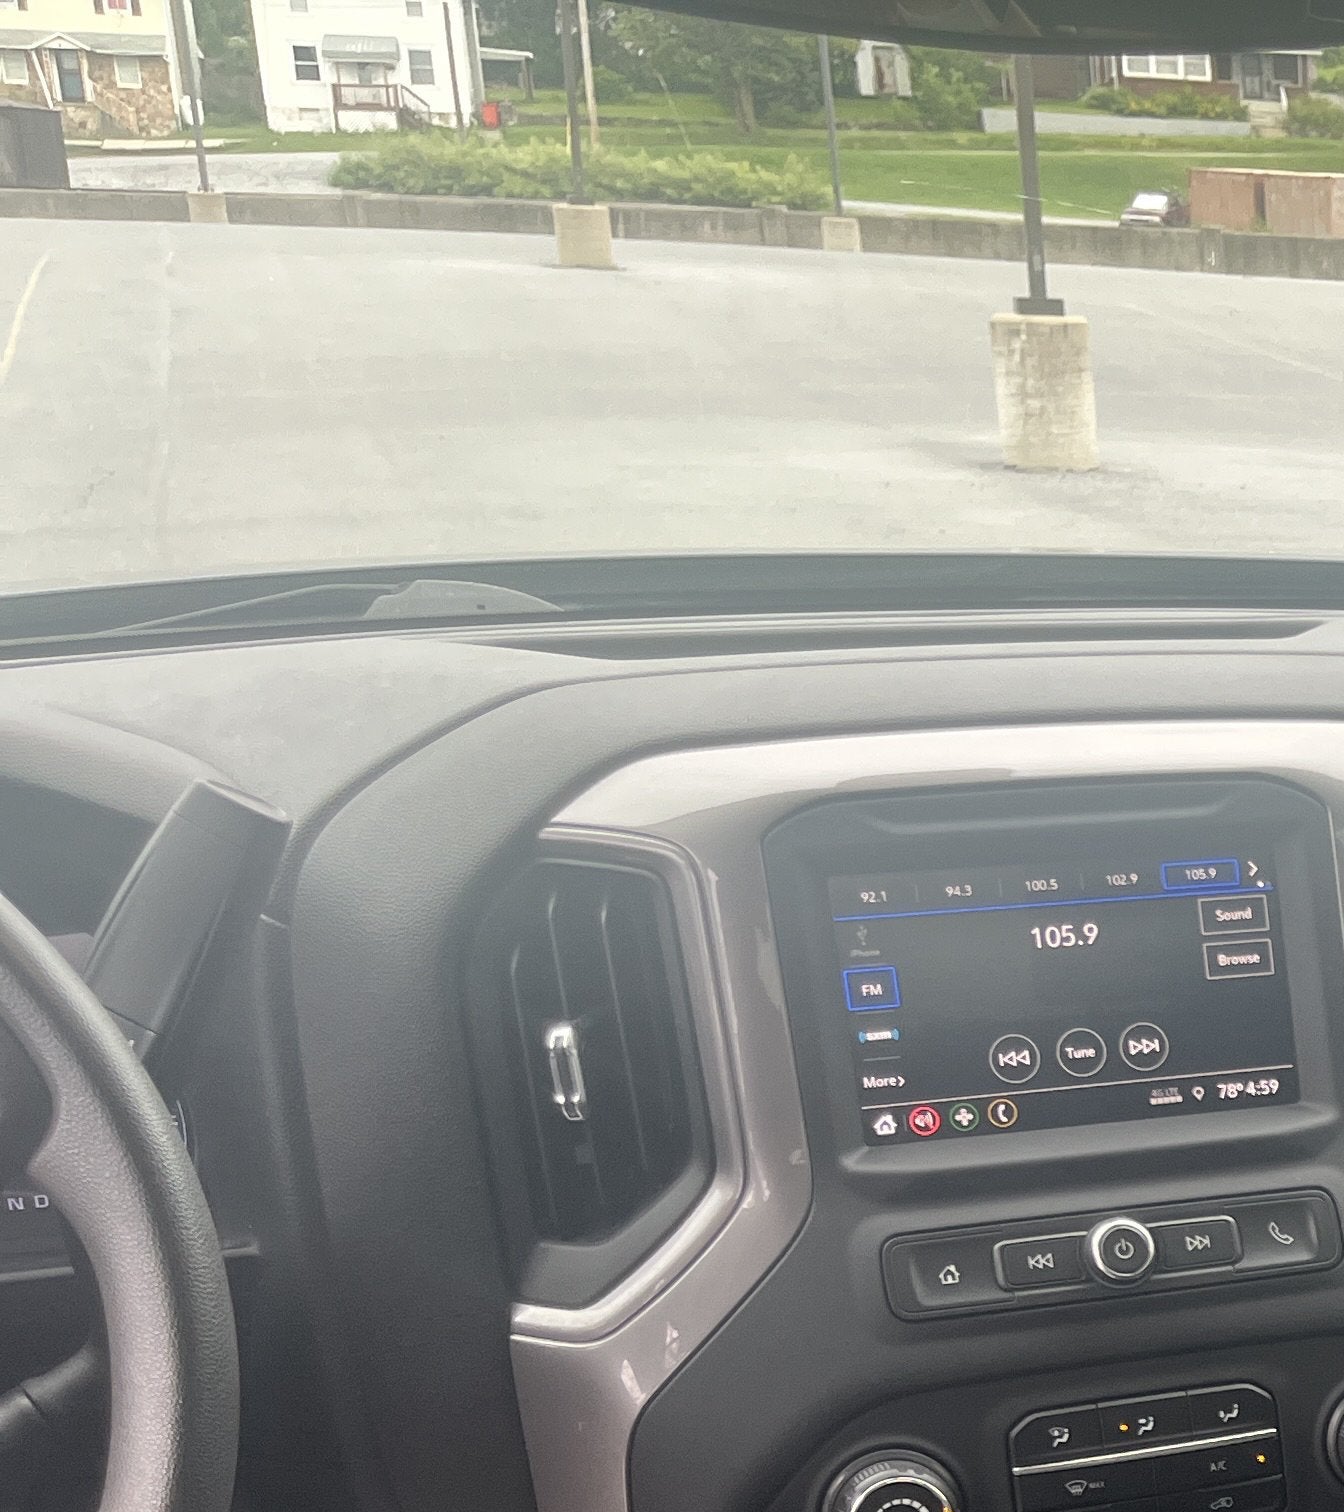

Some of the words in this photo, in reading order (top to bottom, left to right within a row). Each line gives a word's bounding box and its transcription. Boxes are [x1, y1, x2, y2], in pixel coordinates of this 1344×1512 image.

[1105, 873, 1139, 886] 102.9
[1185, 867, 1217, 880] 105.9
[945, 884, 973, 897] 94.3
[1024, 878, 1059, 892] 100.5
[860, 890, 888, 903] 92.1
[1215, 907, 1253, 922] Sound
[1030, 923, 1099, 949] 105.9
[1217, 953, 1261, 967] Browse
[861, 983, 883, 997] FM
[1064, 1047, 1096, 1059] Tune
[862, 1076, 898, 1089] More
[1245, 1079, 1280, 1097] 4:59
[7, 1197, 25, 1211] N
[34, 1194, 49, 1209] D
[1209, 1460, 1228, 1472] A/C
